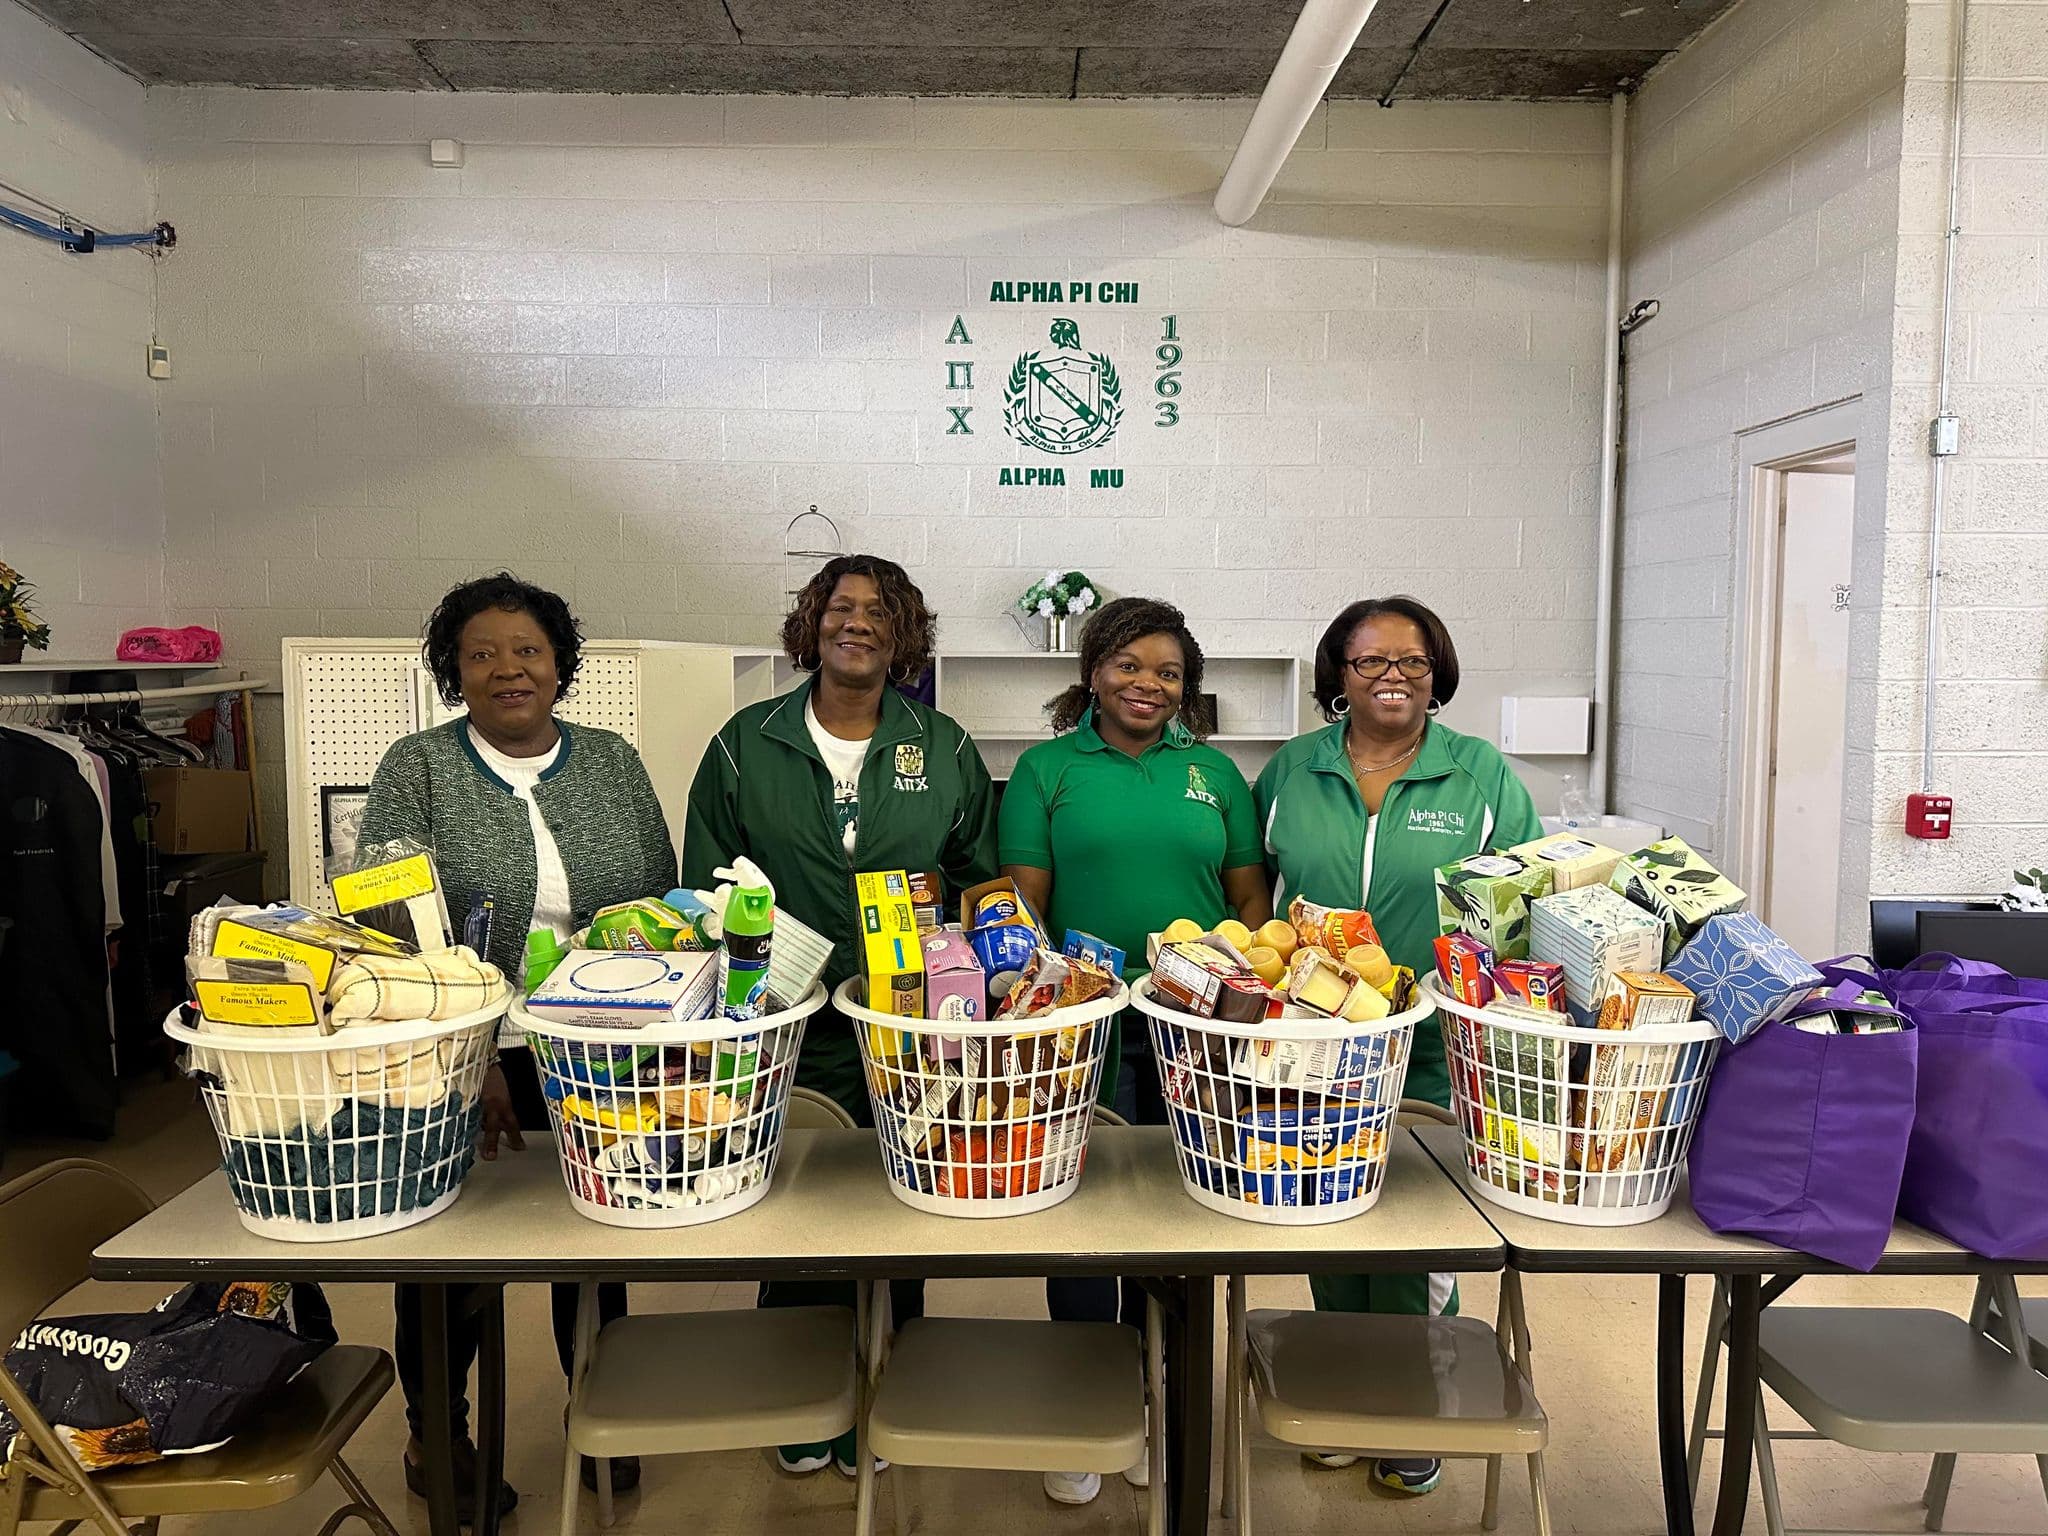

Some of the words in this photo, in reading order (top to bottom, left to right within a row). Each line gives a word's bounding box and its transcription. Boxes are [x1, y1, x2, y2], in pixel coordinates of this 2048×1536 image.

[990, 281, 1064, 303] ALPHA
[1069, 282, 1092, 303] PI
[1098, 282, 1139, 304] CHI
[1028, 434, 1057, 451] ALPHA
[1078, 437, 1094, 449] CHI
[999, 467, 1066, 487] ALPHA
[1090, 468, 1124, 489] MU
[1408, 808, 1437, 825] Alpha
[1437, 810, 1447, 822] Pi
[1448, 812, 1465, 828] Chi
[238, 940, 273, 957] Famous
[276, 951, 308, 966] Makers
[219, 995, 253, 1005] Famous
[255, 995, 289, 1005] Makers
[10, 1324, 131, 1372] Goodwil
